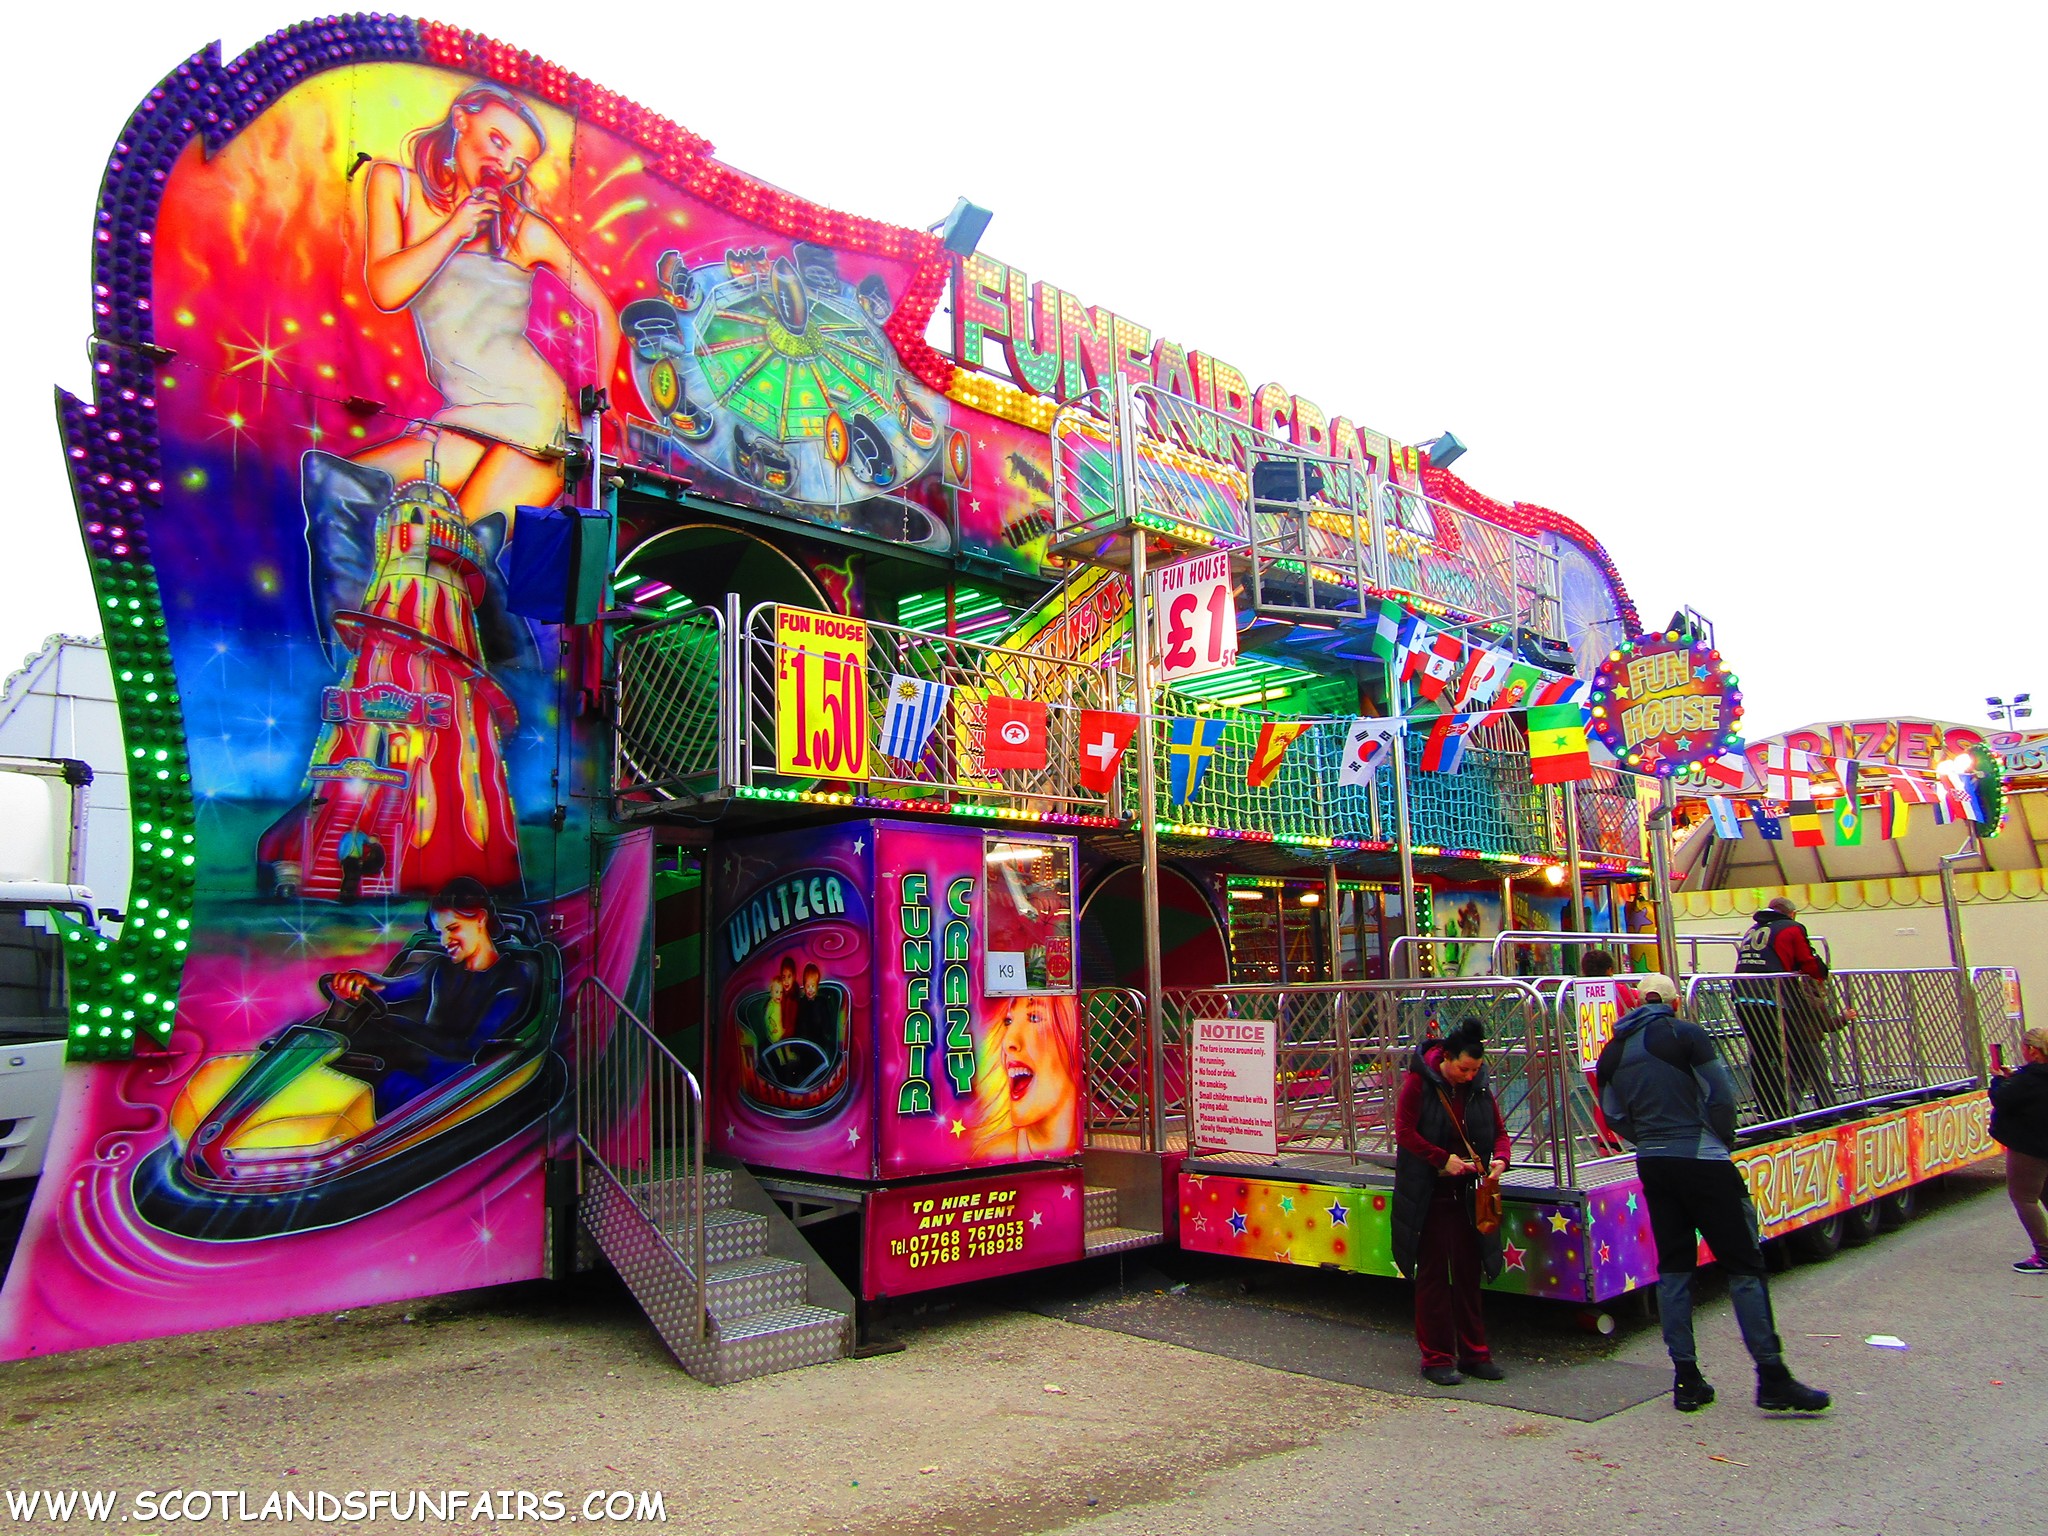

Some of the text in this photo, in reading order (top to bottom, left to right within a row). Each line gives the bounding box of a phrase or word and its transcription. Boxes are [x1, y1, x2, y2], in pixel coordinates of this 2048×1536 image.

[955, 249, 1253, 468] FUNFAIR
[1162, 565, 1184, 592] FUN
[1189, 554, 1226, 585] HOUSE
[780, 612, 864, 642] FUN HOUSE
[1626, 649, 1690, 700] FUN
[1621, 694, 1723, 750] HOUSE
[729, 876, 845, 963] WALTZER
[999, 964, 1015, 979] K9
[897, 873, 932, 1114] FUNFAIR
[944, 878, 976, 1093] CRAZY
[1585, 985, 1606, 998] FARE
[1200, 1024, 1265, 1041] NOTICE
[1200, 1044, 1208, 1052] The
[1209, 1044, 1218, 1053] fare
[1206, 1068, 1216, 1076] food
[1199, 1091, 1212, 1099] Small
[1213, 1092, 1232, 1101] children
[1252, 1096, 1263, 1104] with
[1199, 1102, 1215, 1111] paying
[1200, 1113, 1215, 1122] Please
[1216, 1115, 1227, 1123] walk
[1228, 1116, 1238, 1124] with
[1239, 1117, 1254, 1125] hands
[1260, 1118, 1273, 1127] front
[1201, 1124, 1215, 1133] slowly
[1216, 1124, 1234, 1135] through
[1201, 1135, 1208, 1143] No
[1734, 1096, 1994, 1226] RAZY FUN HOUSE
[912, 1199, 935, 1214] TO
[941, 1193, 981, 1210] HIRE
[918, 1204, 1016, 1230] ANY EVENT
[909, 1229, 960, 1252] 07768
[967, 1220, 1024, 1242] 767053
[909, 1235, 1024, 1268] 07768 718928
